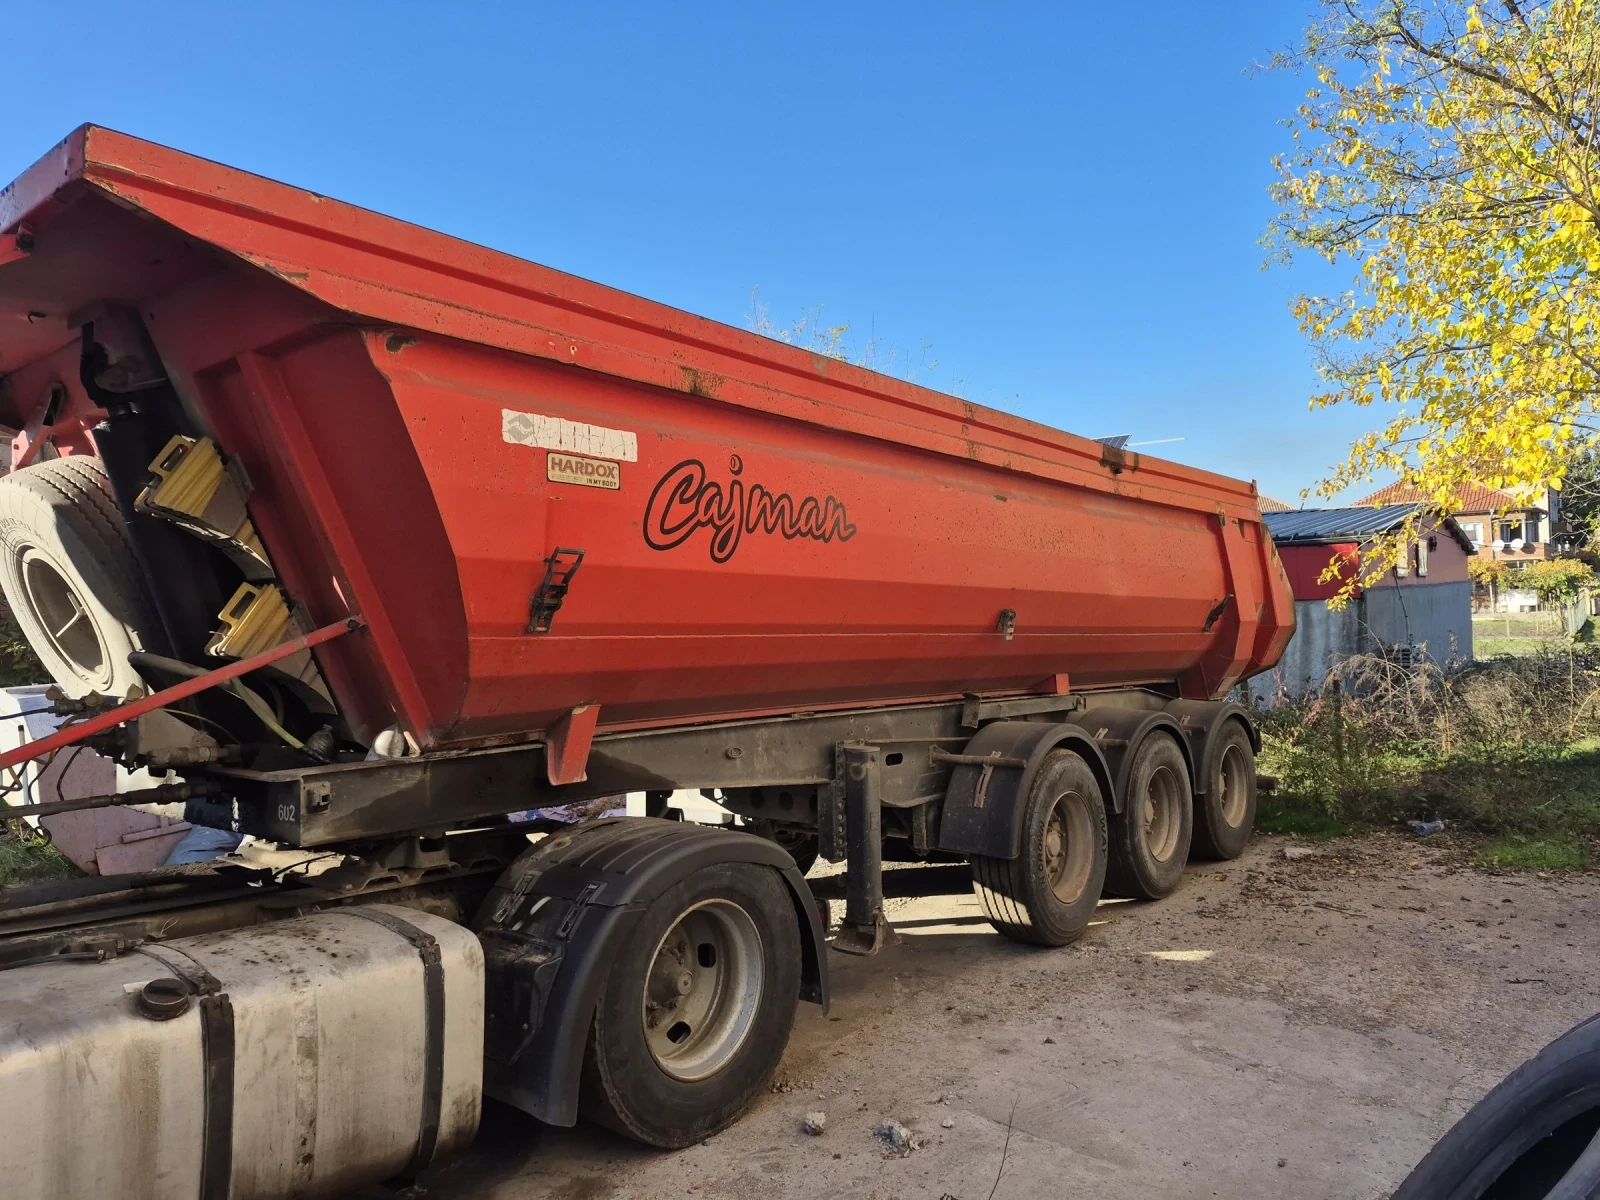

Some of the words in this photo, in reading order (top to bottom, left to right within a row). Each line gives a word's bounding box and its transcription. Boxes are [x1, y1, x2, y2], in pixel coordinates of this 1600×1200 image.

[551, 457, 617, 479] HARDOX
[602, 480, 617, 488] BODY
[643, 454, 857, 563] Cajman
[278, 804, 296, 822] 602
